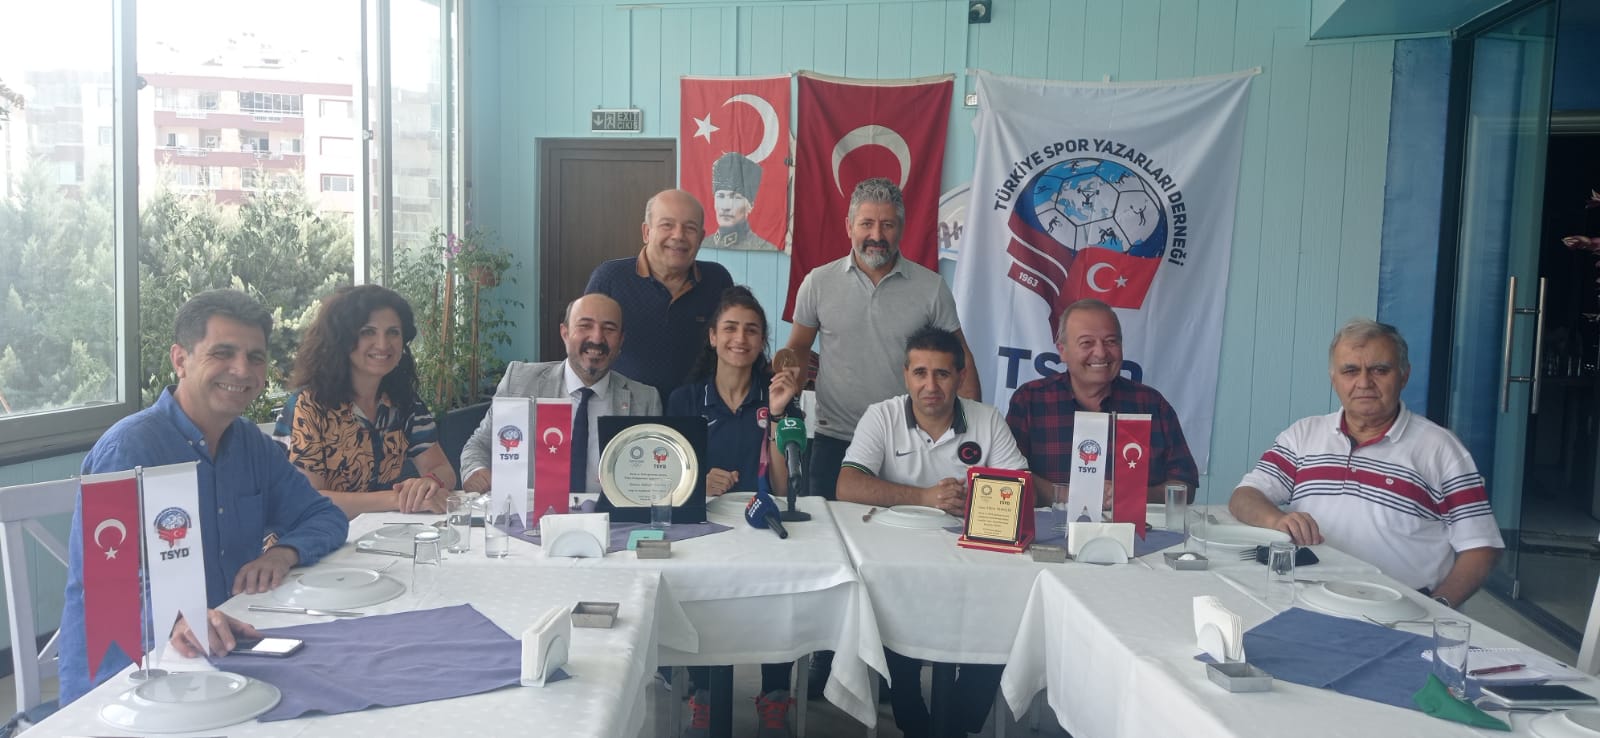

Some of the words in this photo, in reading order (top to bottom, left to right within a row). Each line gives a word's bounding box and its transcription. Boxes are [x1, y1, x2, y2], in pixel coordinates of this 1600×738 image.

[993, 151, 1044, 211] TÜRKİYE
[1043, 138, 1089, 159] SPOR
[1093, 138, 1176, 193] YAZARLARI
[1167, 190, 1187, 267] DERNEĞİ
[1019, 271, 1039, 287] 1963
[998, 346, 1143, 389] TS
[500, 453, 519, 461] TSYD
[1078, 466, 1097, 474] TSYD
[160, 548, 189, 560] TSYD
